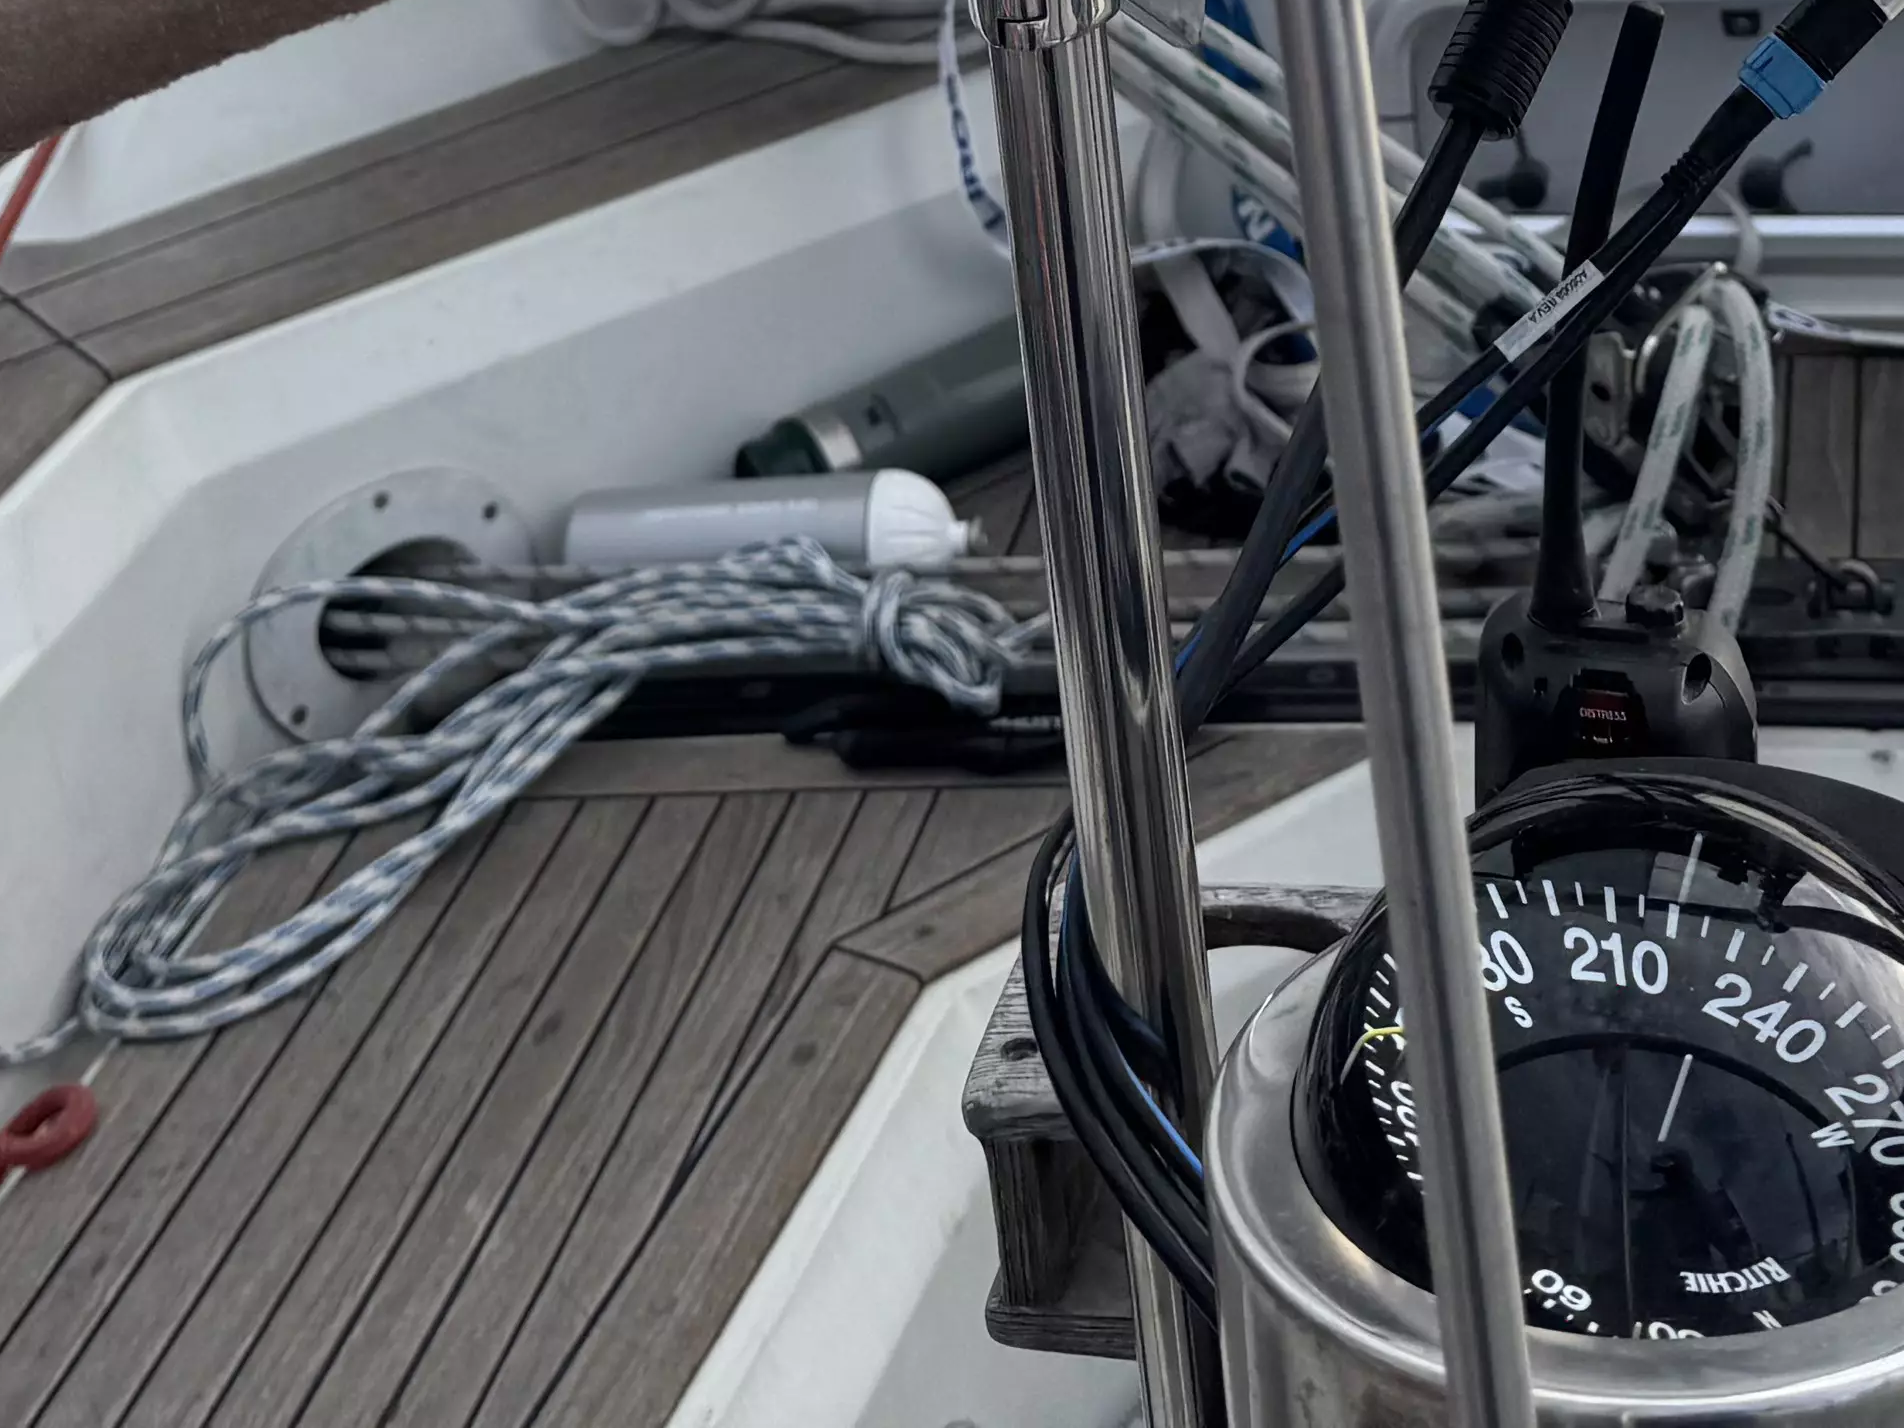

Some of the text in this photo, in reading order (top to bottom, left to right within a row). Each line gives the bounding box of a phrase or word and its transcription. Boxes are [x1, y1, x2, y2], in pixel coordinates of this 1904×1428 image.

[1478, 930, 1533, 992] 80
[1563, 927, 1669, 995] 210
[1504, 996, 1533, 1028] S
[1701, 972, 1827, 1063] 240
[1810, 1122, 1855, 1148] W
[1680, 1256, 1792, 1294] RITCHIE
